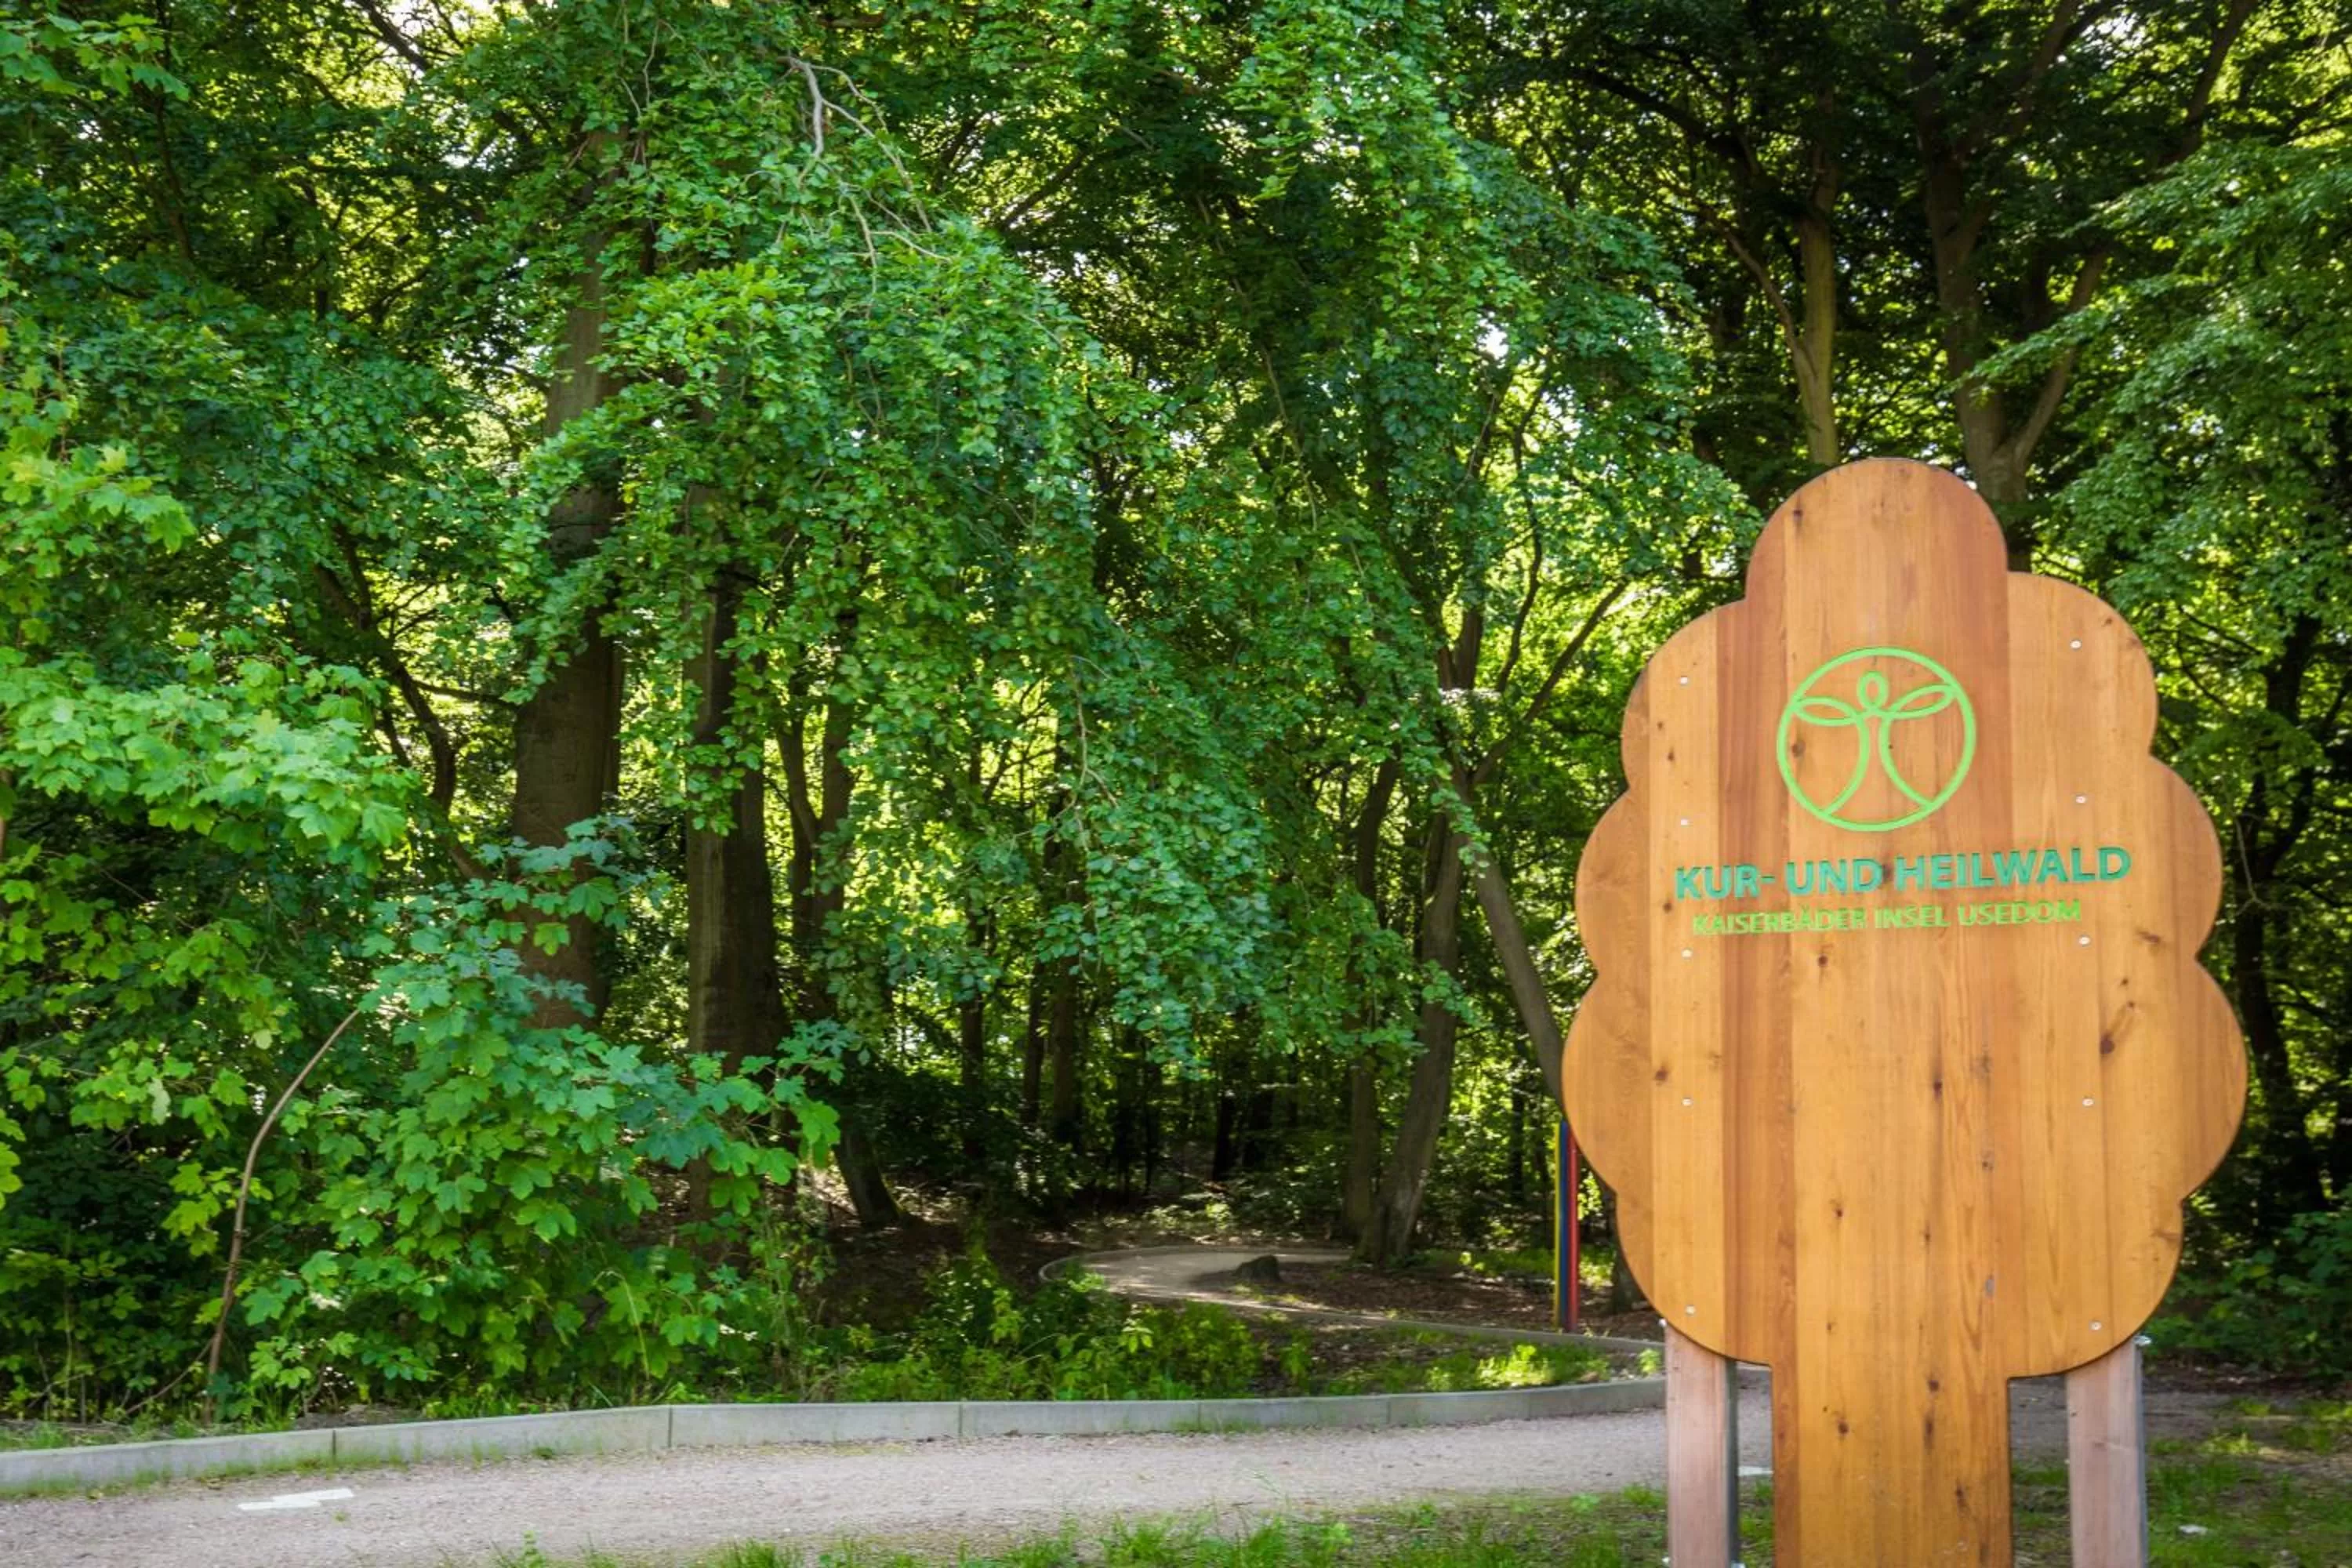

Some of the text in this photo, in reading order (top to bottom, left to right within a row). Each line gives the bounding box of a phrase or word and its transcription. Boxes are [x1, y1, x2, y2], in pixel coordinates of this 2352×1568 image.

[1676, 846, 2132, 899] KUR- UND HEILWALD
[1692, 899, 2081, 935] KAISERBÄDER INSEL USEDOM
